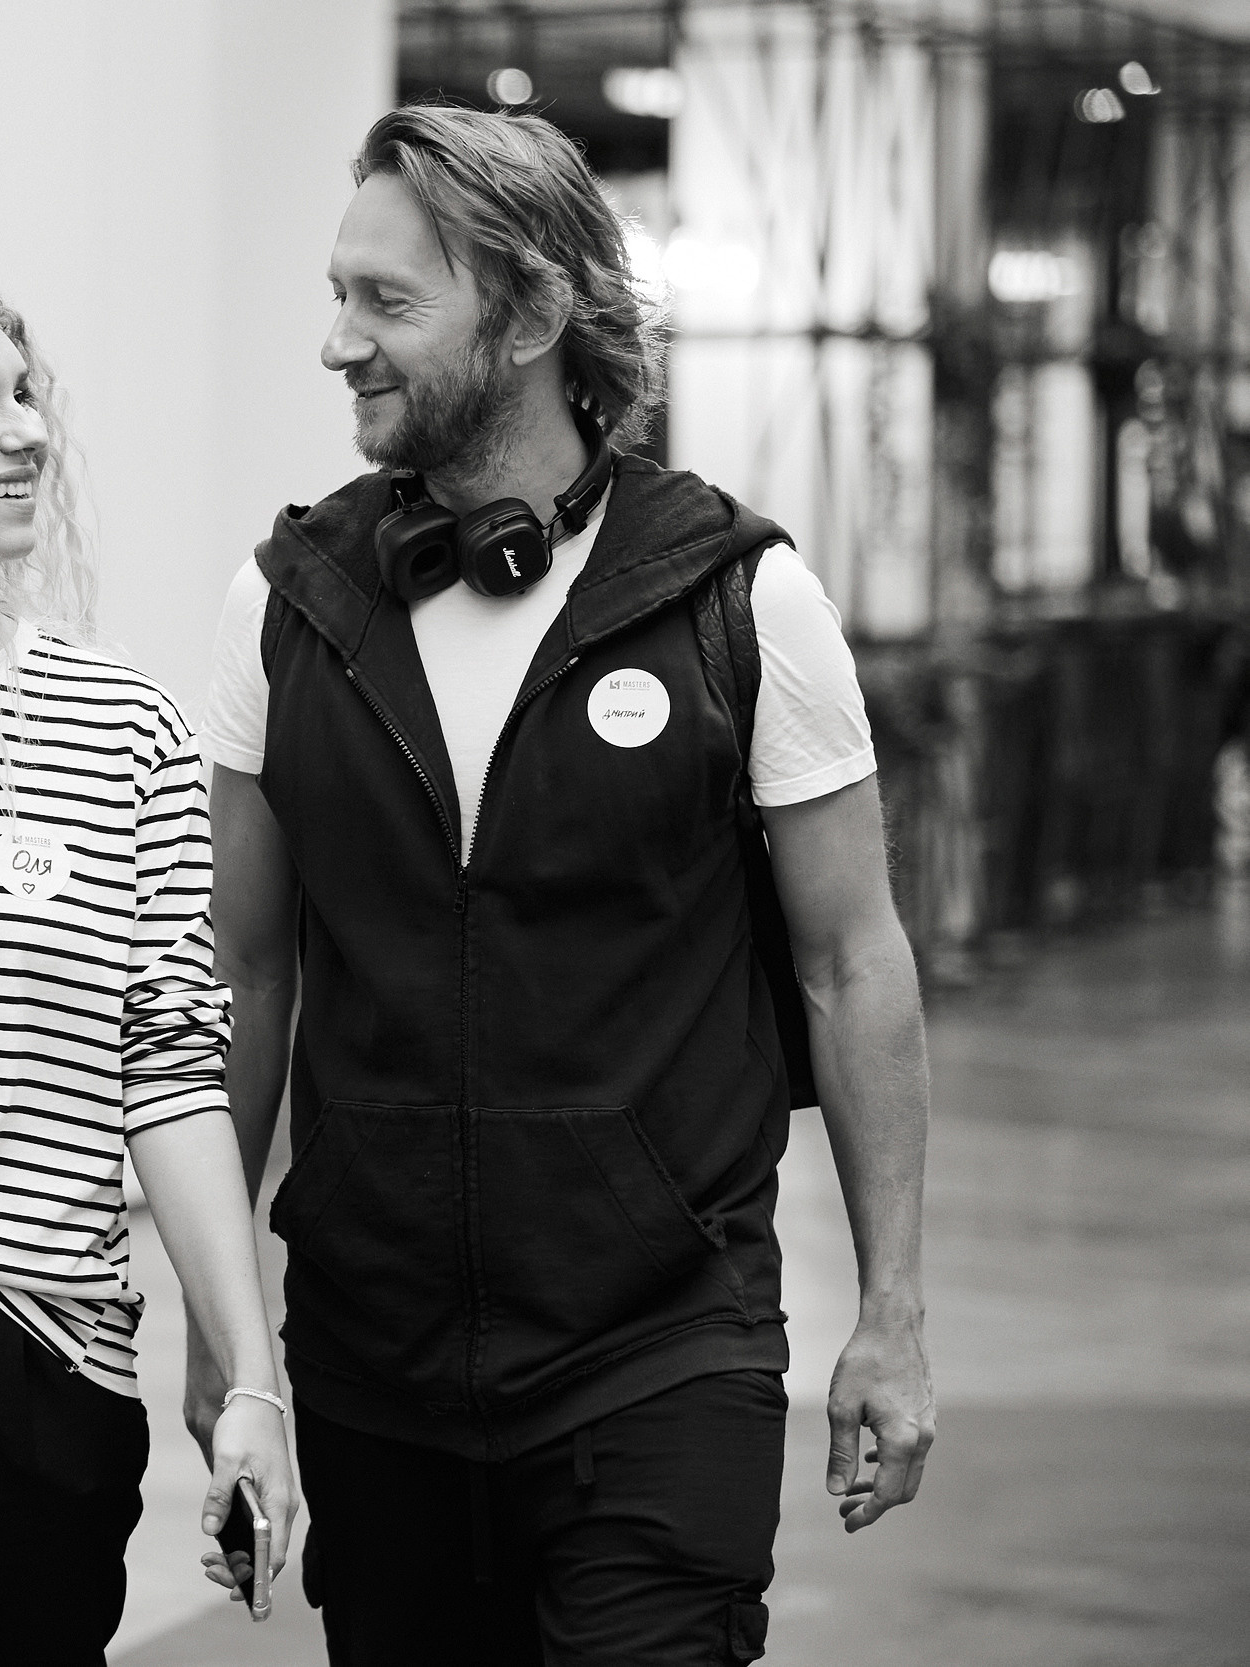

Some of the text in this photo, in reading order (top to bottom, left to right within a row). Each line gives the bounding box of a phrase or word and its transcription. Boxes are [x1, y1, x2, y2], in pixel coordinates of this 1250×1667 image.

[502, 547, 522, 578] Marshall
[622, 680, 651, 689] MASTERS
[24, 836, 51, 846] MASTERS
